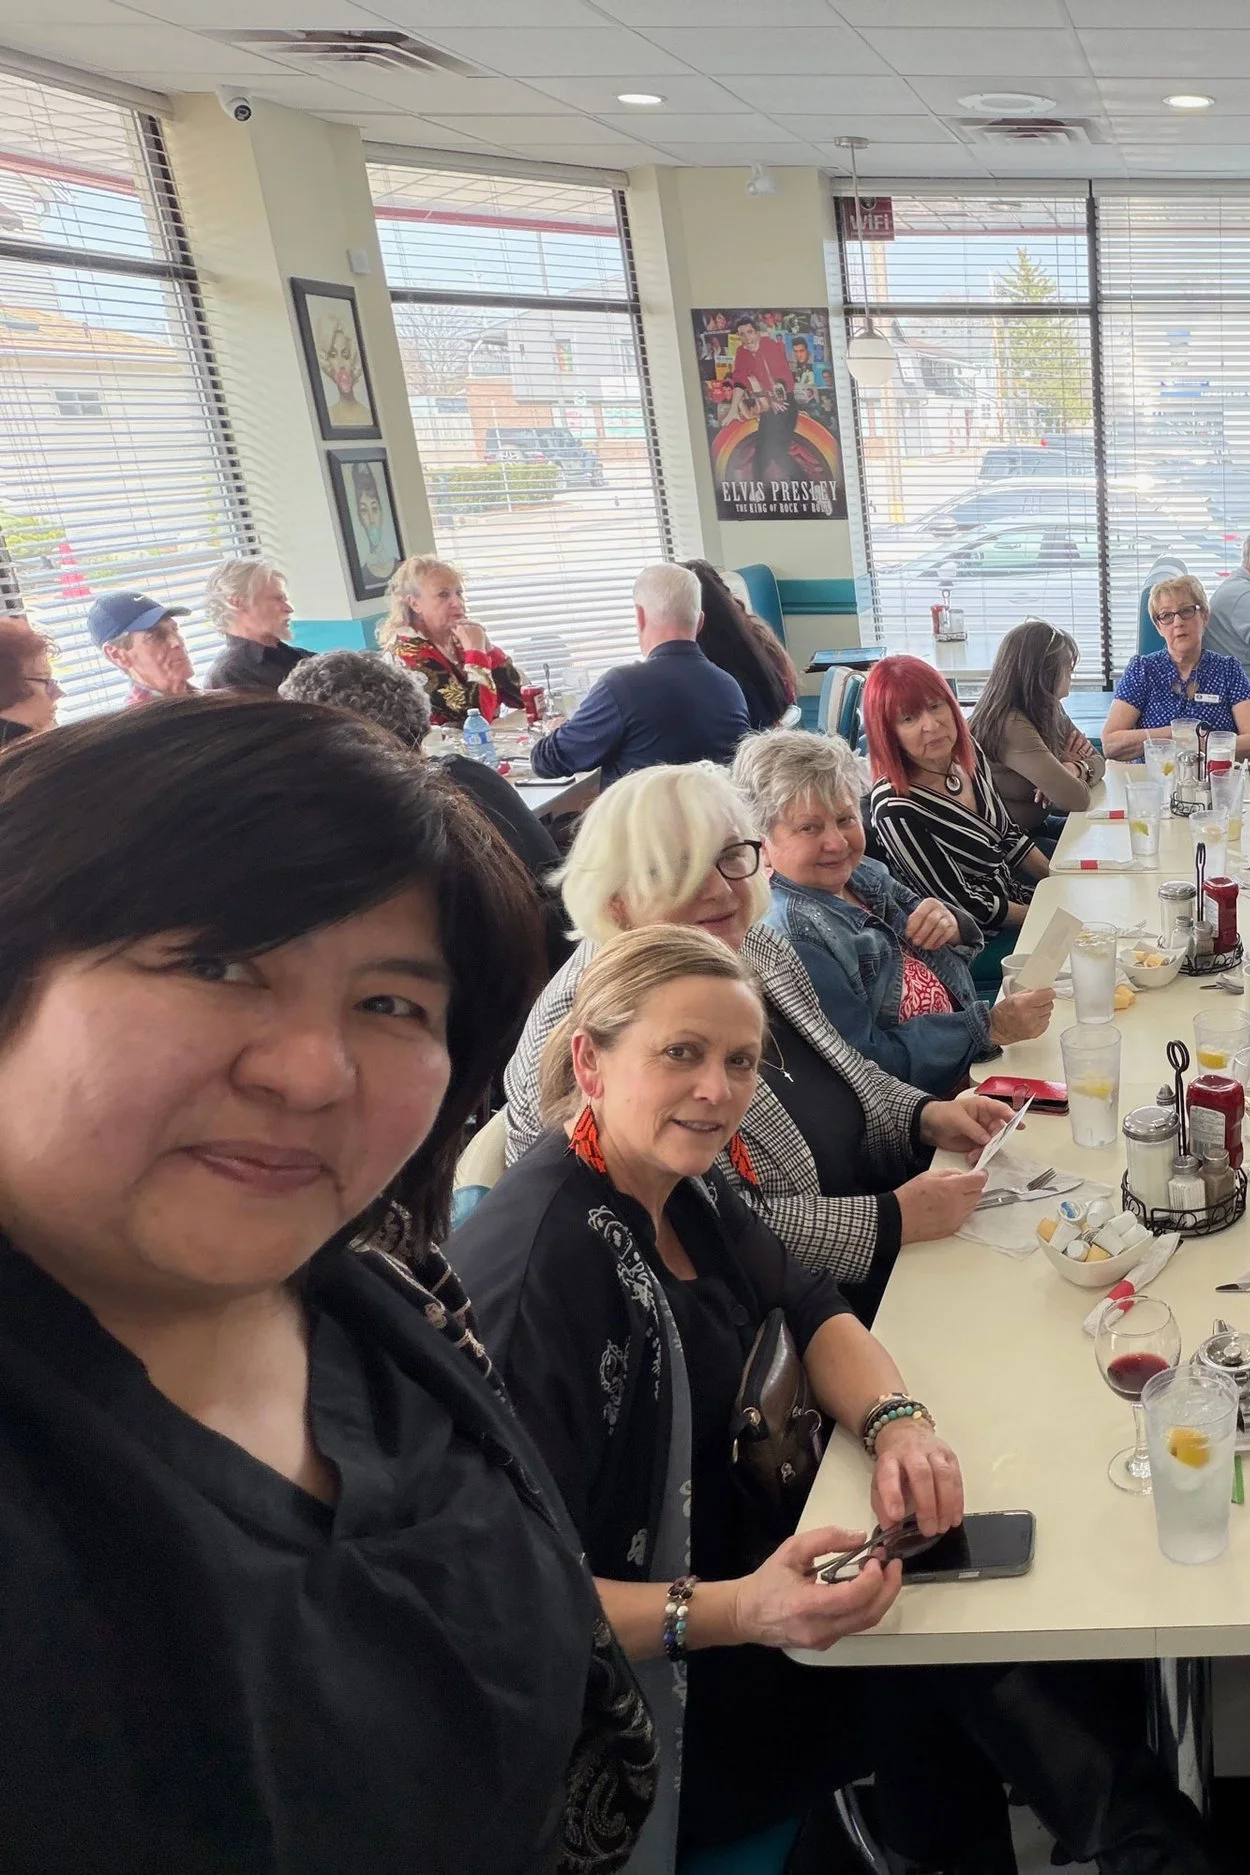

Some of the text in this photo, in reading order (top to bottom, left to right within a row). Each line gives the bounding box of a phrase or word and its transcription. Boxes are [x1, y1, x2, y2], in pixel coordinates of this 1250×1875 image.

[850, 213, 890, 230] WiFi
[721, 480, 837, 501] ELVIS PRESLEY
[736, 503, 748, 512] THE
[749, 503, 767, 513] KING
[769, 503, 777, 513] OF
[780, 502, 798, 513] ROCK
